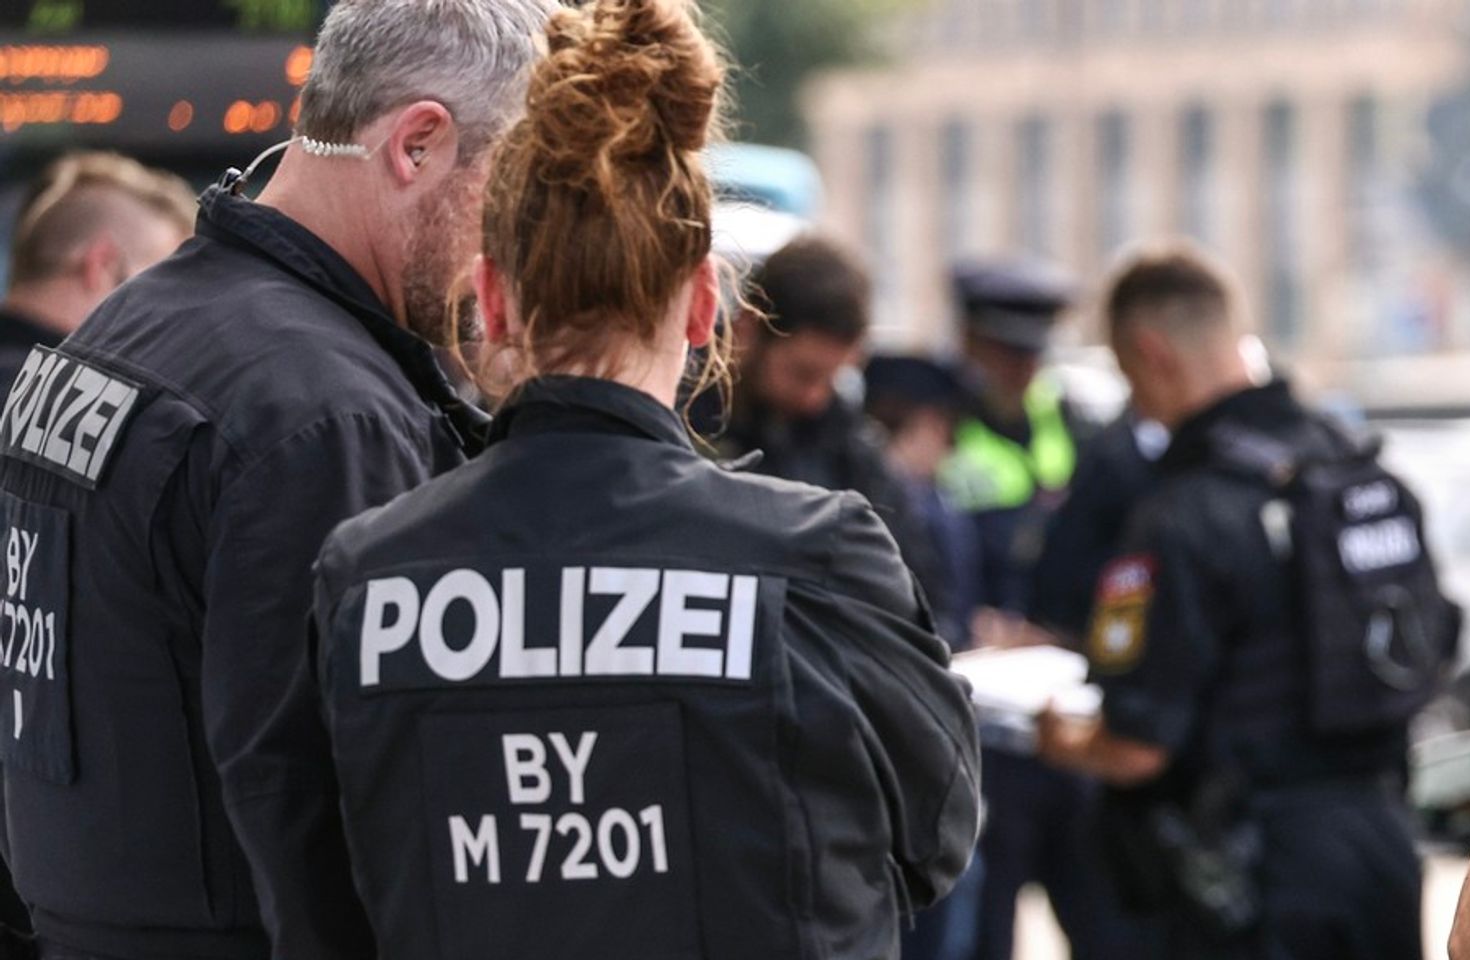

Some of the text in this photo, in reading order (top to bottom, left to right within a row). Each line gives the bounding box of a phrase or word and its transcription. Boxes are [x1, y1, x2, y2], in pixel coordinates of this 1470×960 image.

[0, 348, 139, 481] POLIZEI
[7, 526, 38, 601] BY
[360, 566, 758, 687] POLIZEI
[502, 731, 598, 804] BY
[448, 804, 669, 884] M 7201
